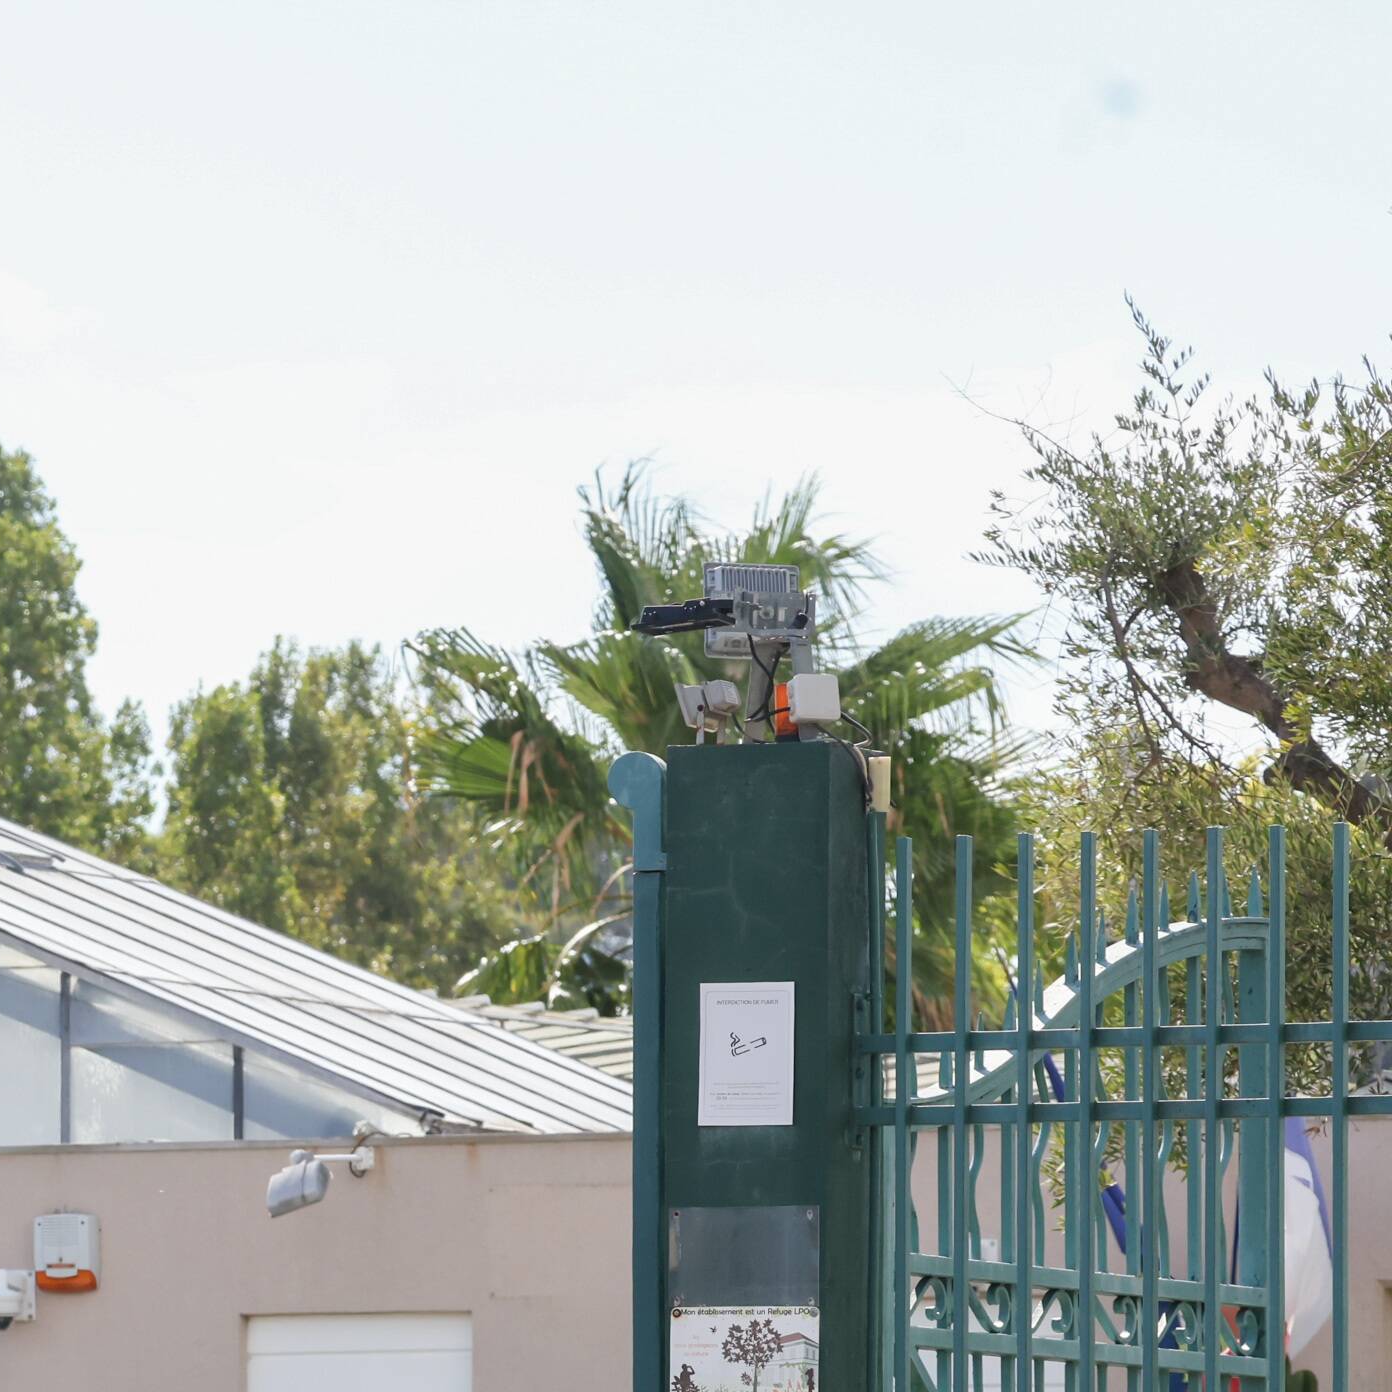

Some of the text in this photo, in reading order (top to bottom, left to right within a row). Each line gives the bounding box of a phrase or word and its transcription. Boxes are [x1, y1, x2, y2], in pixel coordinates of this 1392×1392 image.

[698, 1308, 743, 1316] établissement
[768, 1308, 792, 1317] Refuge
[794, 1308, 810, 1316] LPO
